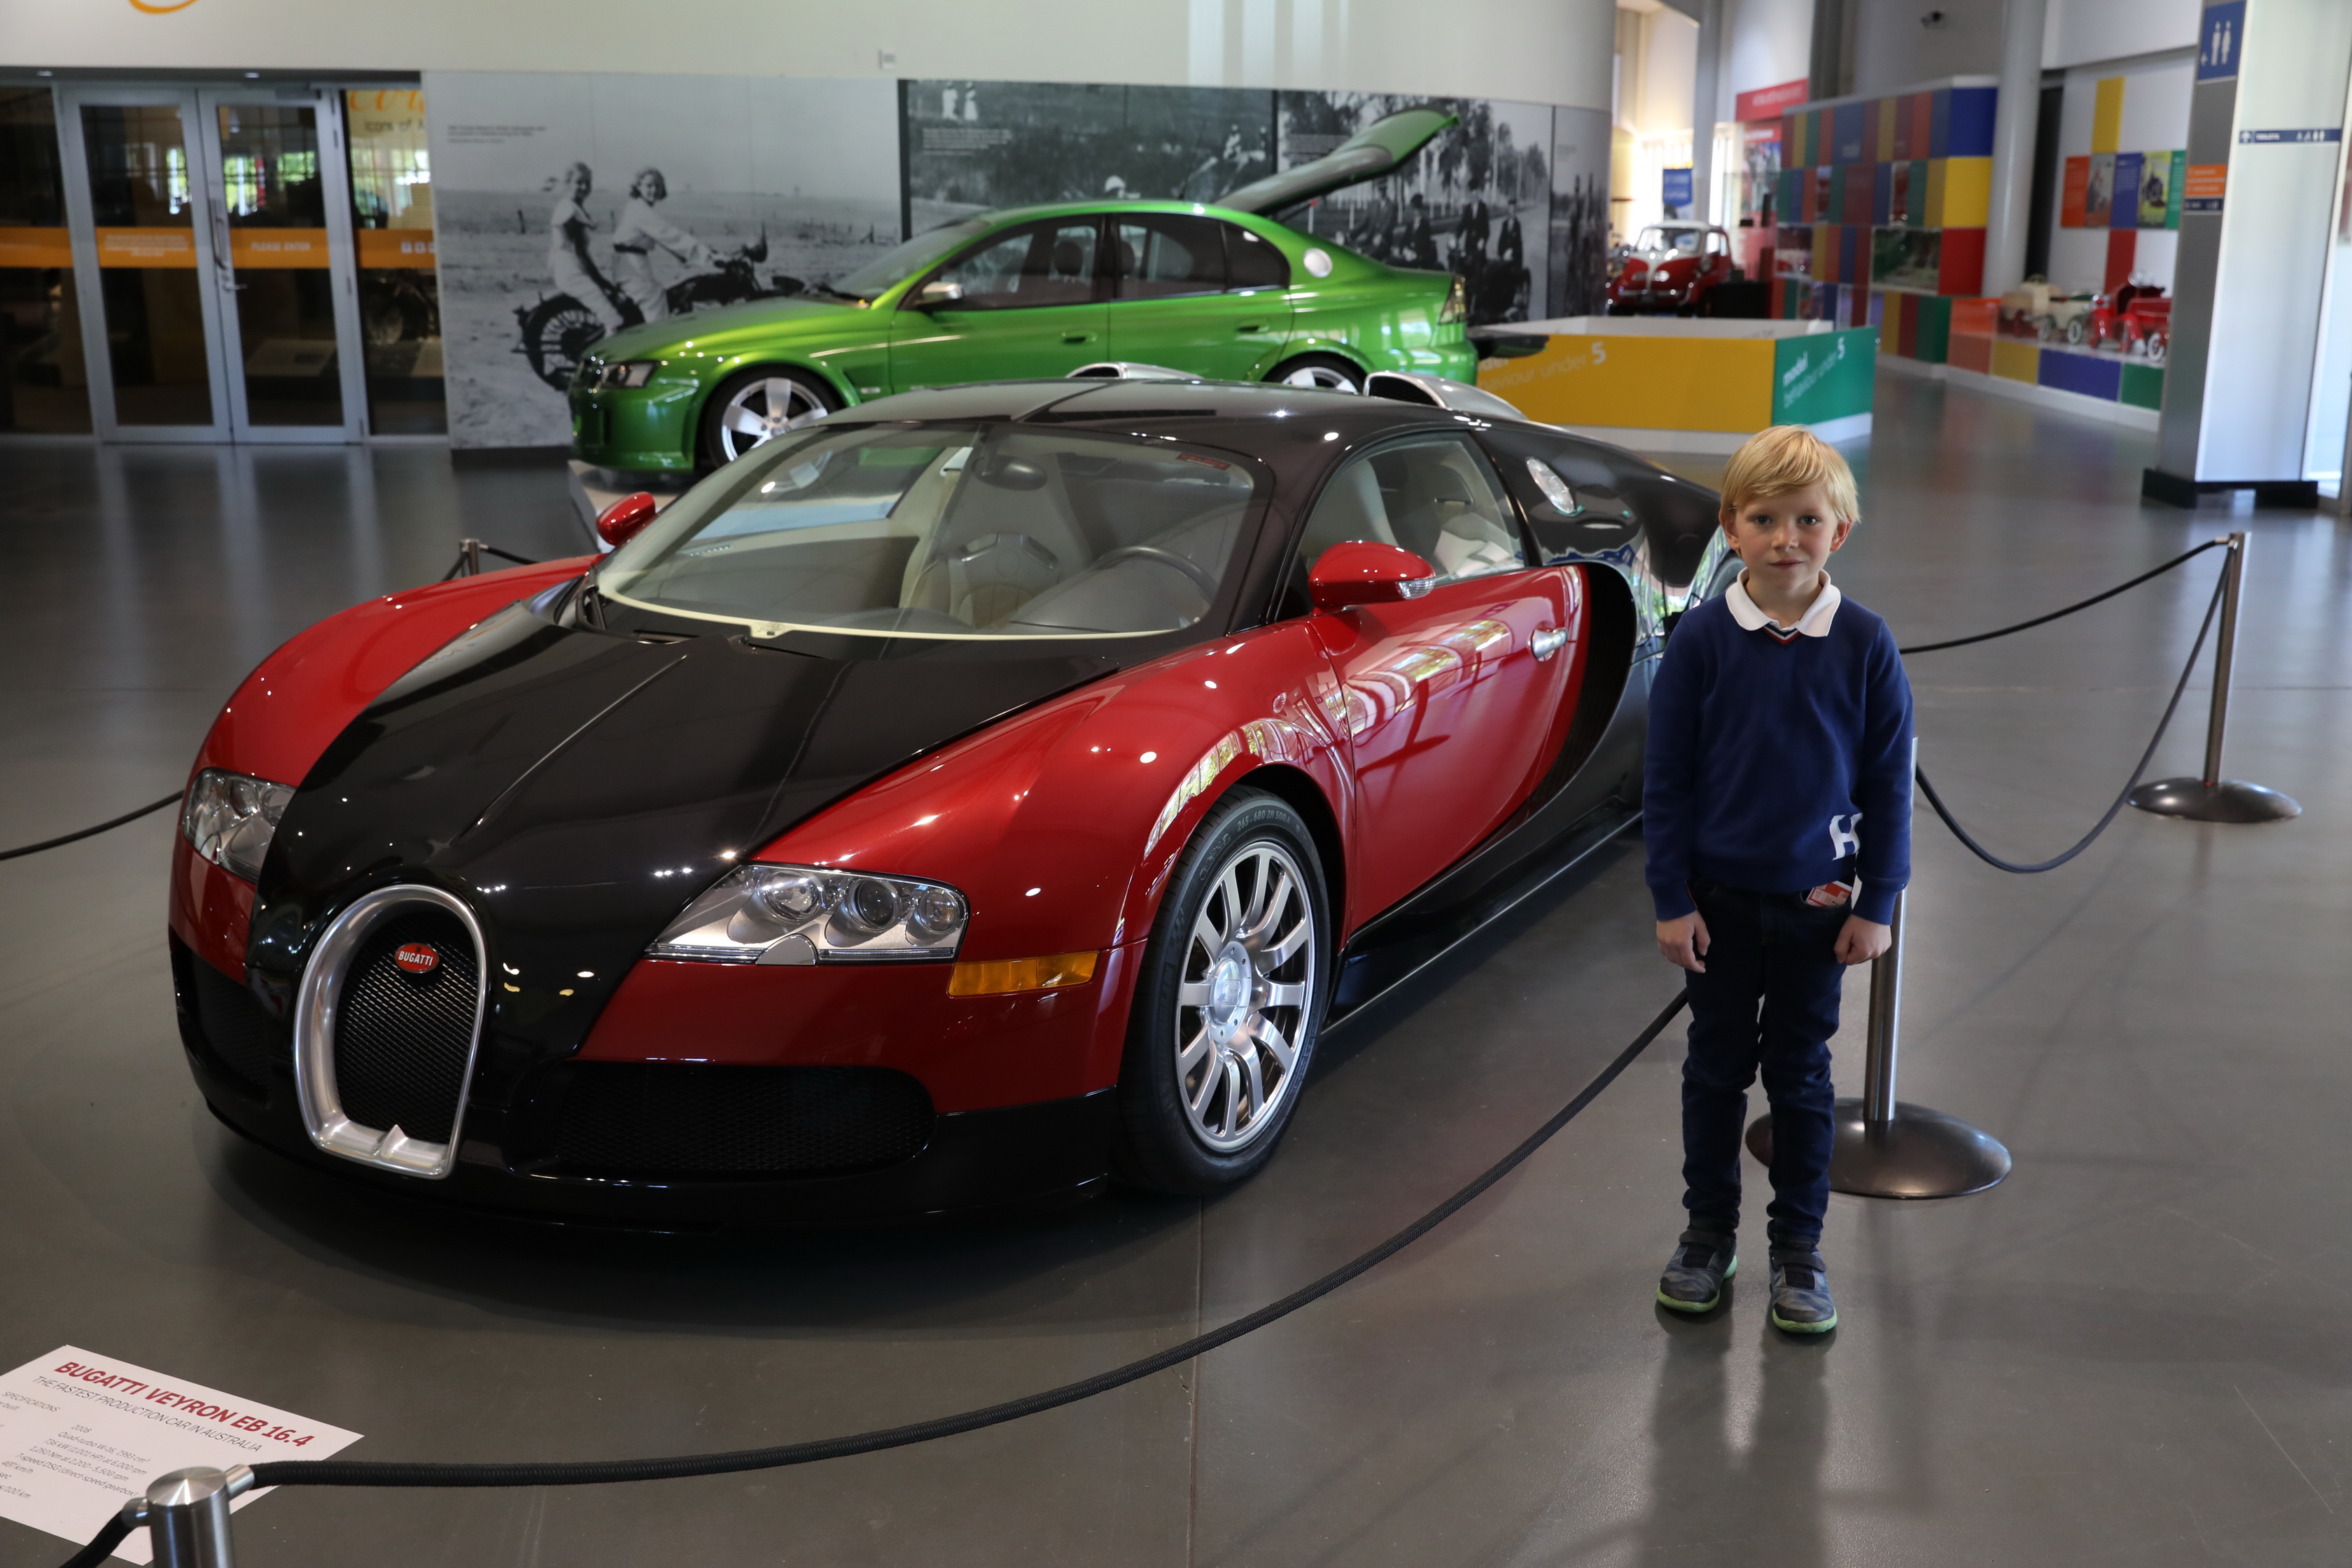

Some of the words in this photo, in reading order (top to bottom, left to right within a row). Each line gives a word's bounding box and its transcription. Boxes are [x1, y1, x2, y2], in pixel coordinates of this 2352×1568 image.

[1591, 341, 1606, 365] 5
[1837, 337, 1845, 360] 5
[1275, 811, 1286, 821] 500
[398, 951, 434, 966] BUGATTI
[1, 1391, 60, 1413] SPECIFICATIONS
[54, 1362, 149, 1395] BUGATTI
[145, 1388, 238, 1423] VEYRON
[230, 1415, 269, 1432] EB
[260, 1426, 315, 1447] 16.4
[33, 1376, 57, 1388] THE
[52, 1381, 102, 1401] FASTEST
[95, 1396, 170, 1422] PRODUCTION
[165, 1417, 191, 1429] CAR
[188, 1424, 205, 1434] IN
[199, 1429, 262, 1452] AUSTRALIA
[57, 1432, 97, 1447] Quad-turbo
[71, 1424, 92, 1434] 2008
[43, 1438, 59, 1446] 736
[57, 1441, 71, 1450] kW
[89, 1453, 106, 1462] HP)
[130, 1466, 148, 1476] rpm
[48, 1451, 62, 1460] Nm
[113, 1474, 130, 1482] rpm
[15, 1452, 46, 1466] 7-speed
[42, 1462, 62, 1471] DSG
[57, 1467, 106, 1486] (direct-speed
[102, 1482, 139, 1497] gearbox)
